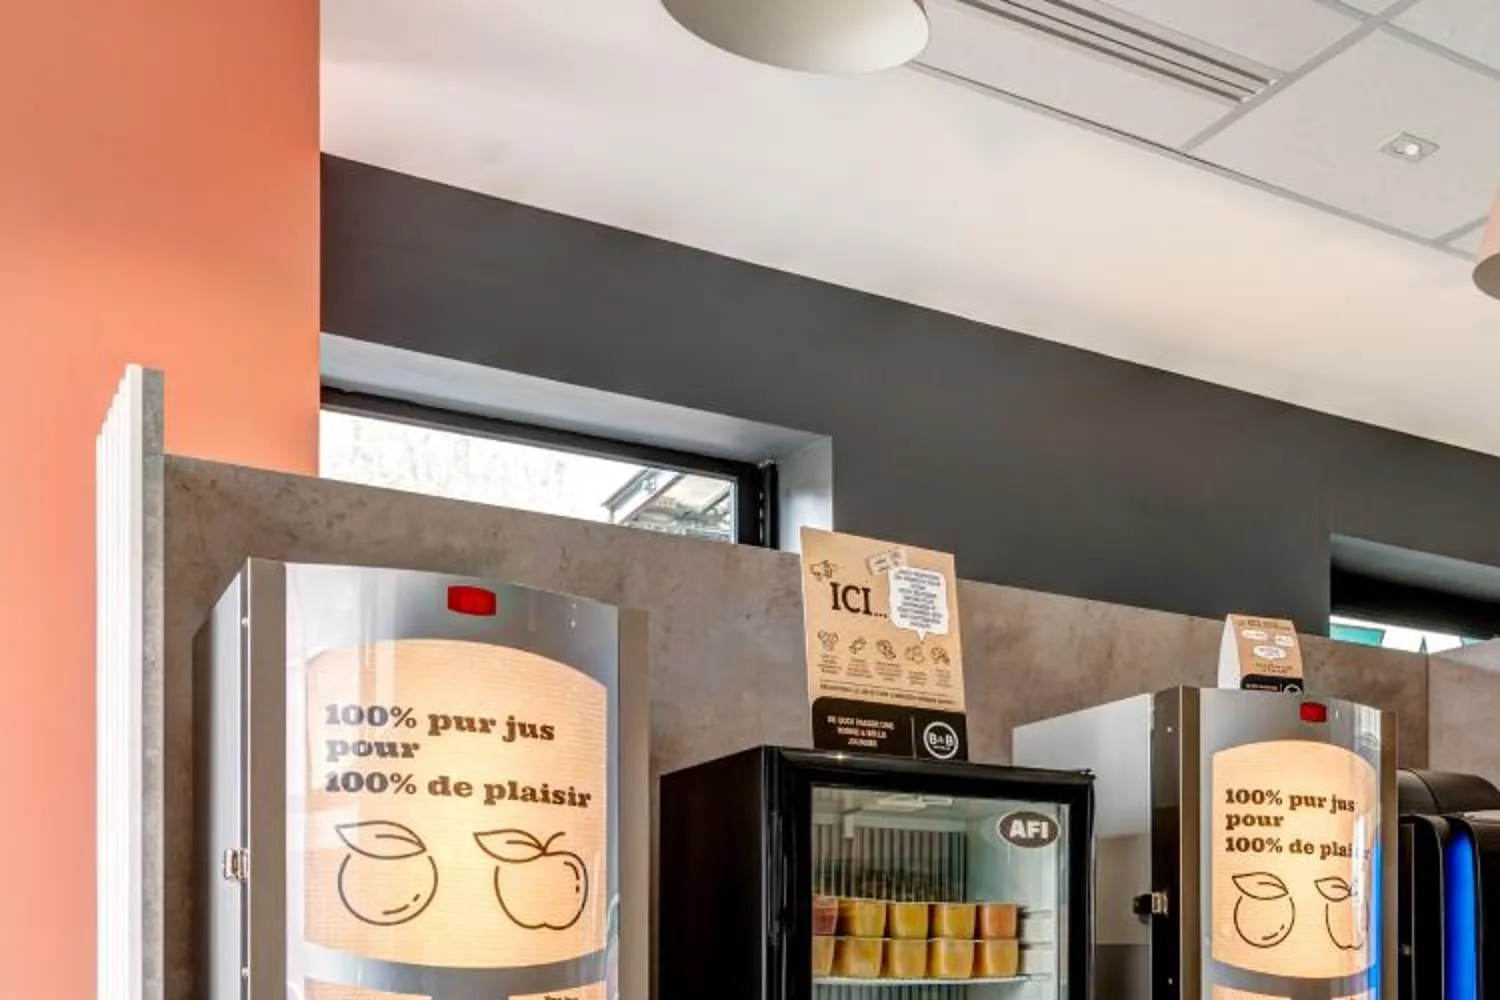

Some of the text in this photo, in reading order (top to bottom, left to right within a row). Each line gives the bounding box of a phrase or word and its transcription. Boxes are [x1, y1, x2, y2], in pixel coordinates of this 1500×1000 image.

[325, 704, 555, 742] 100% pur jus
[325, 740, 420, 762] pour
[325, 771, 592, 808] 100% de plaisir
[1225, 788, 1355, 815] 100% pur jus
[1009, 819, 1049, 839] AFI
[1225, 813, 1284, 831] pour
[1225, 837, 1283, 853] 100%
[1289, 839, 1315, 855] de
